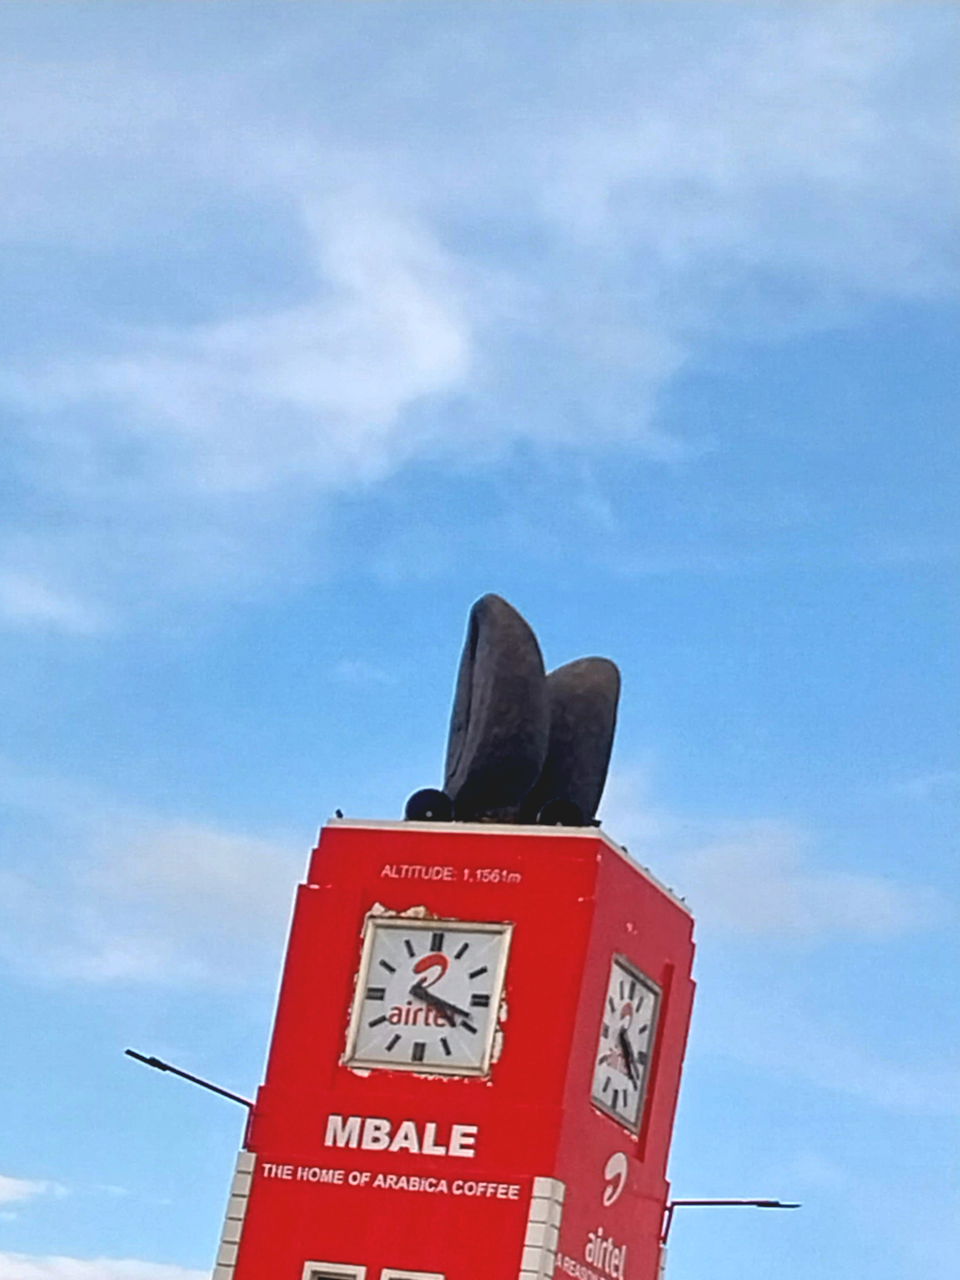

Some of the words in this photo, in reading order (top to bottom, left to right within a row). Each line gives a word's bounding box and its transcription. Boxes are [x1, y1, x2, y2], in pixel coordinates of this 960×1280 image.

[381, 864, 457, 881] ALTITUDE:
[324, 1114, 478, 1158] MBALE
[262, 1163, 293, 1180] THE
[297, 1167, 345, 1184] HOME
[348, 1171, 371, 1186] OF
[373, 1174, 448, 1194] ARABICA
[452, 1180, 521, 1200] COFFEE
